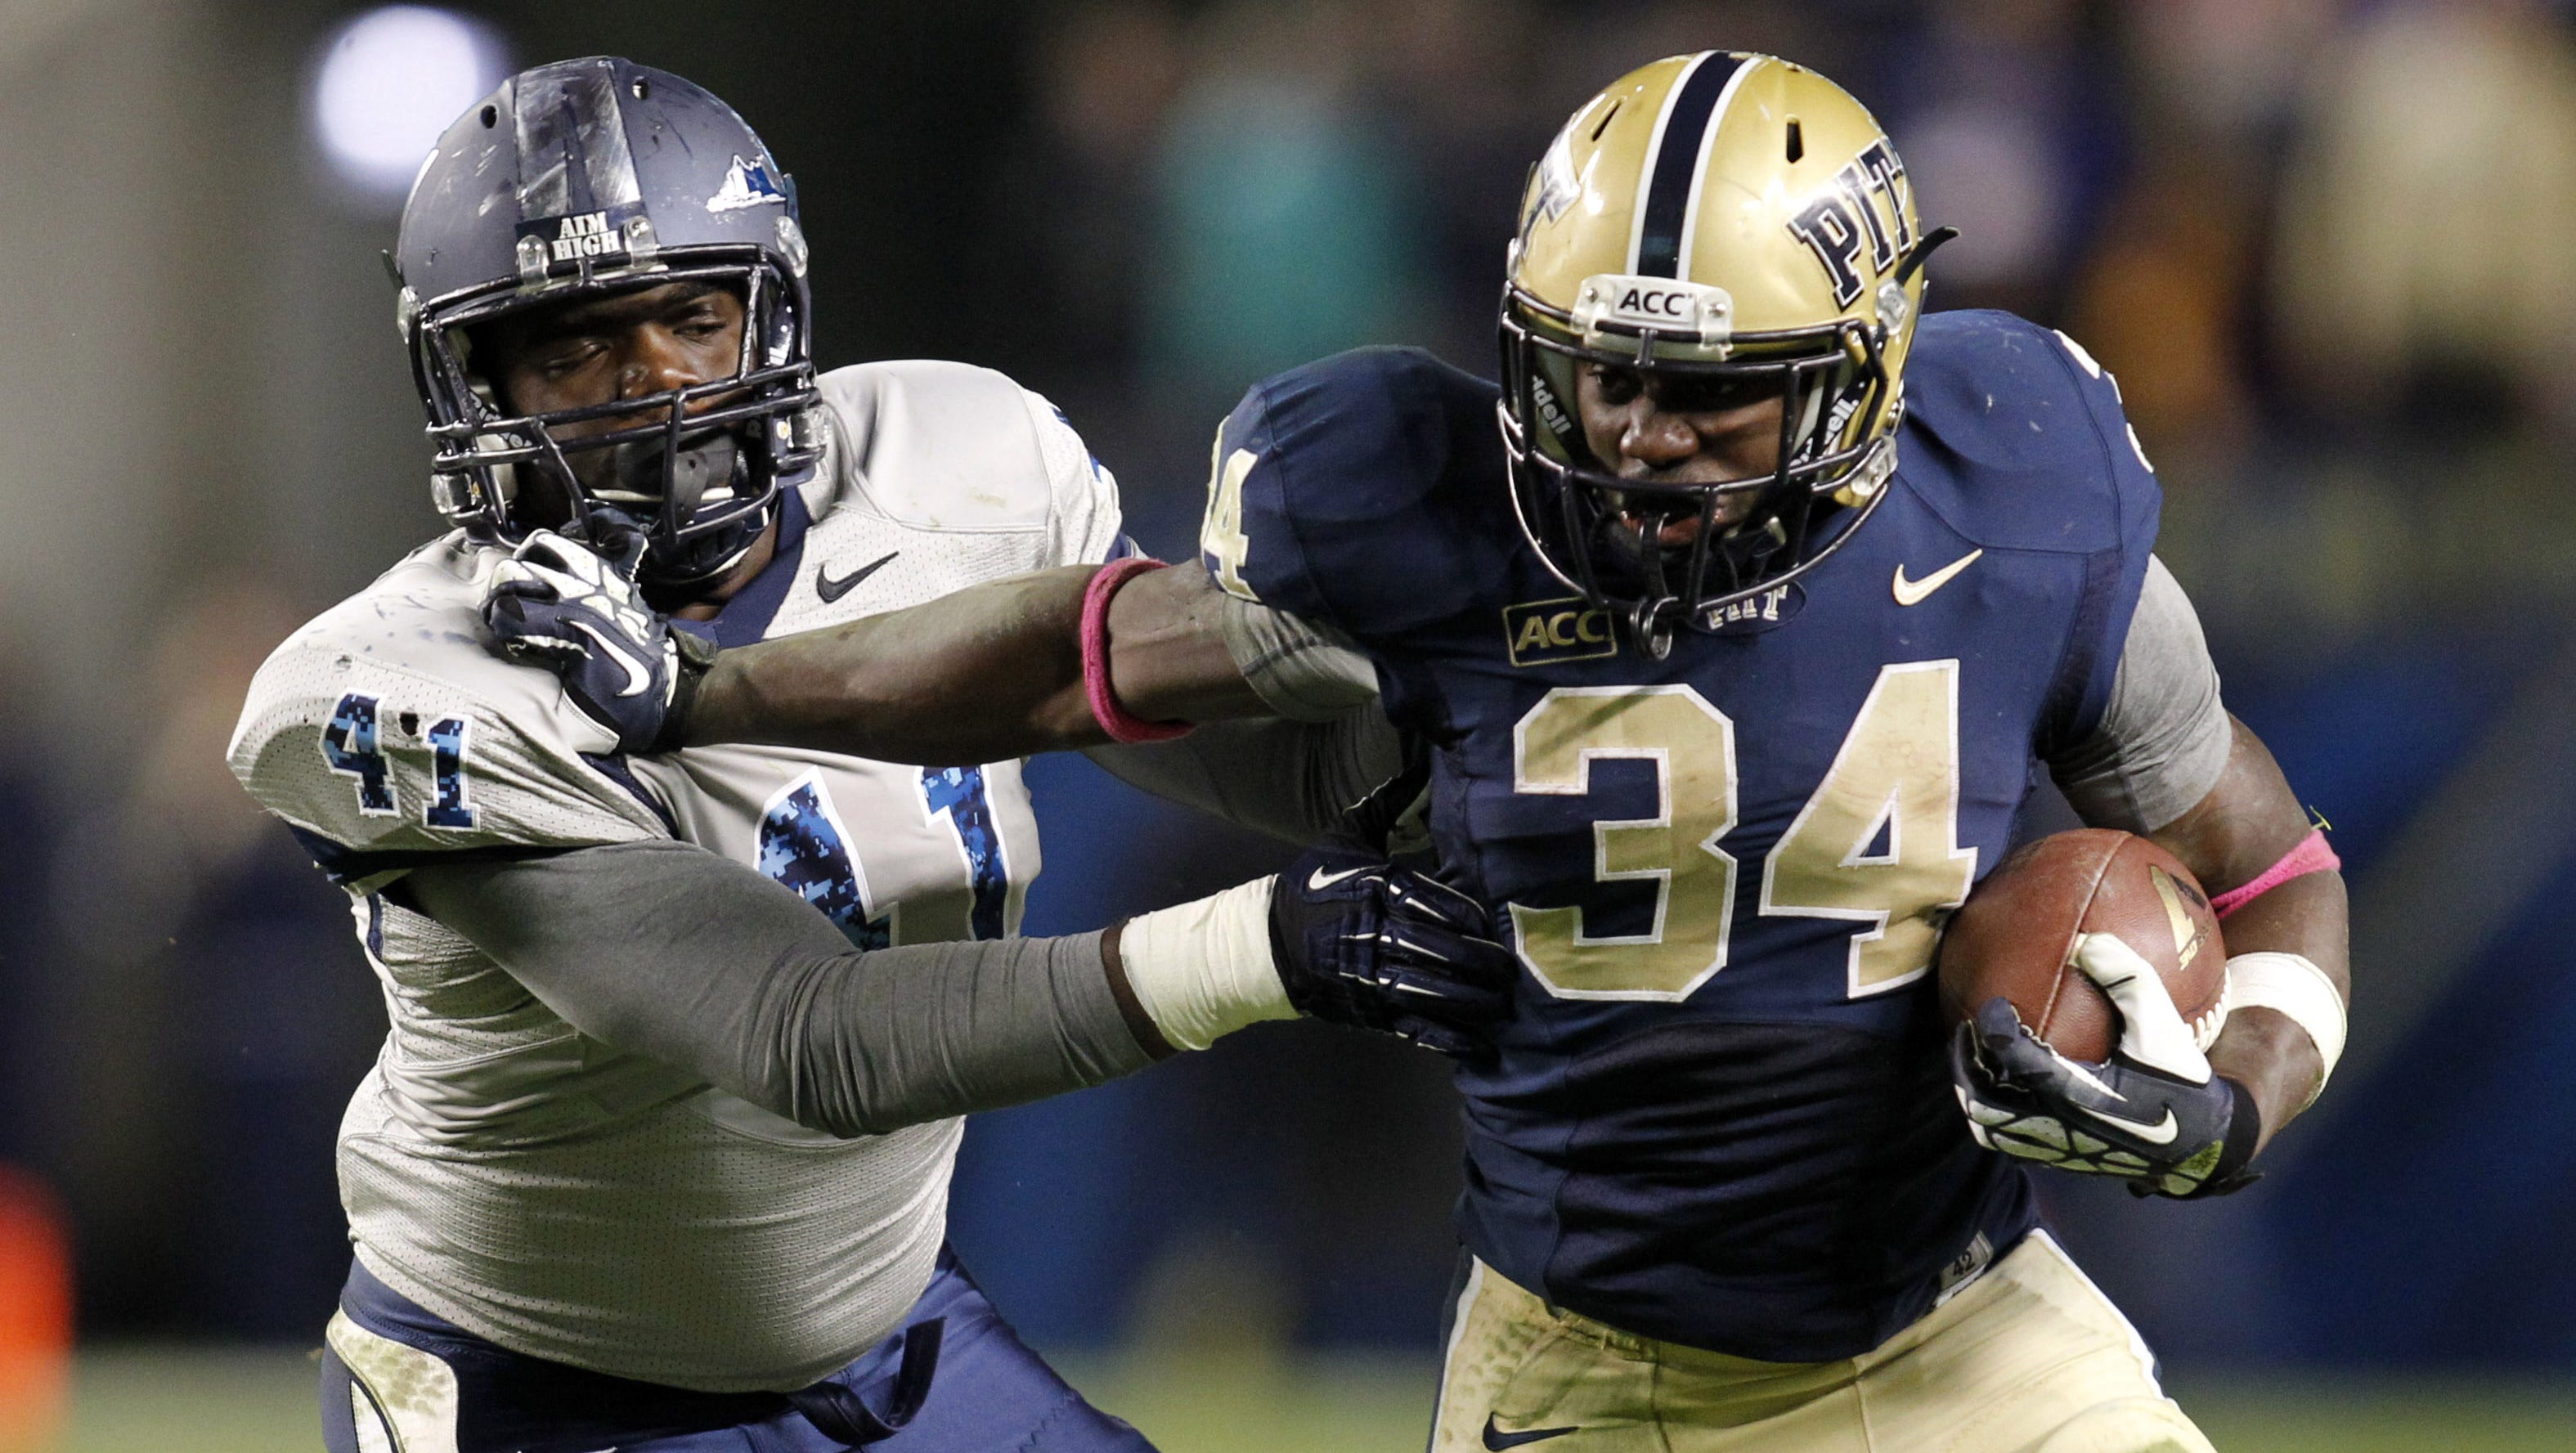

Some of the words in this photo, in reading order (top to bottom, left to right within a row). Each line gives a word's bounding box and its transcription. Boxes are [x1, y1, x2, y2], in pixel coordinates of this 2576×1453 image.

[551, 230, 621, 261] HIGH
[559, 211, 608, 240] AIM
[1785, 137, 1913, 312] PIT
[1618, 289, 1686, 316] ACC
[1200, 415, 1262, 603] 4
[1515, 608, 1605, 653] ACC
[318, 686, 481, 832] 41
[1509, 658, 1979, 1002] 34
